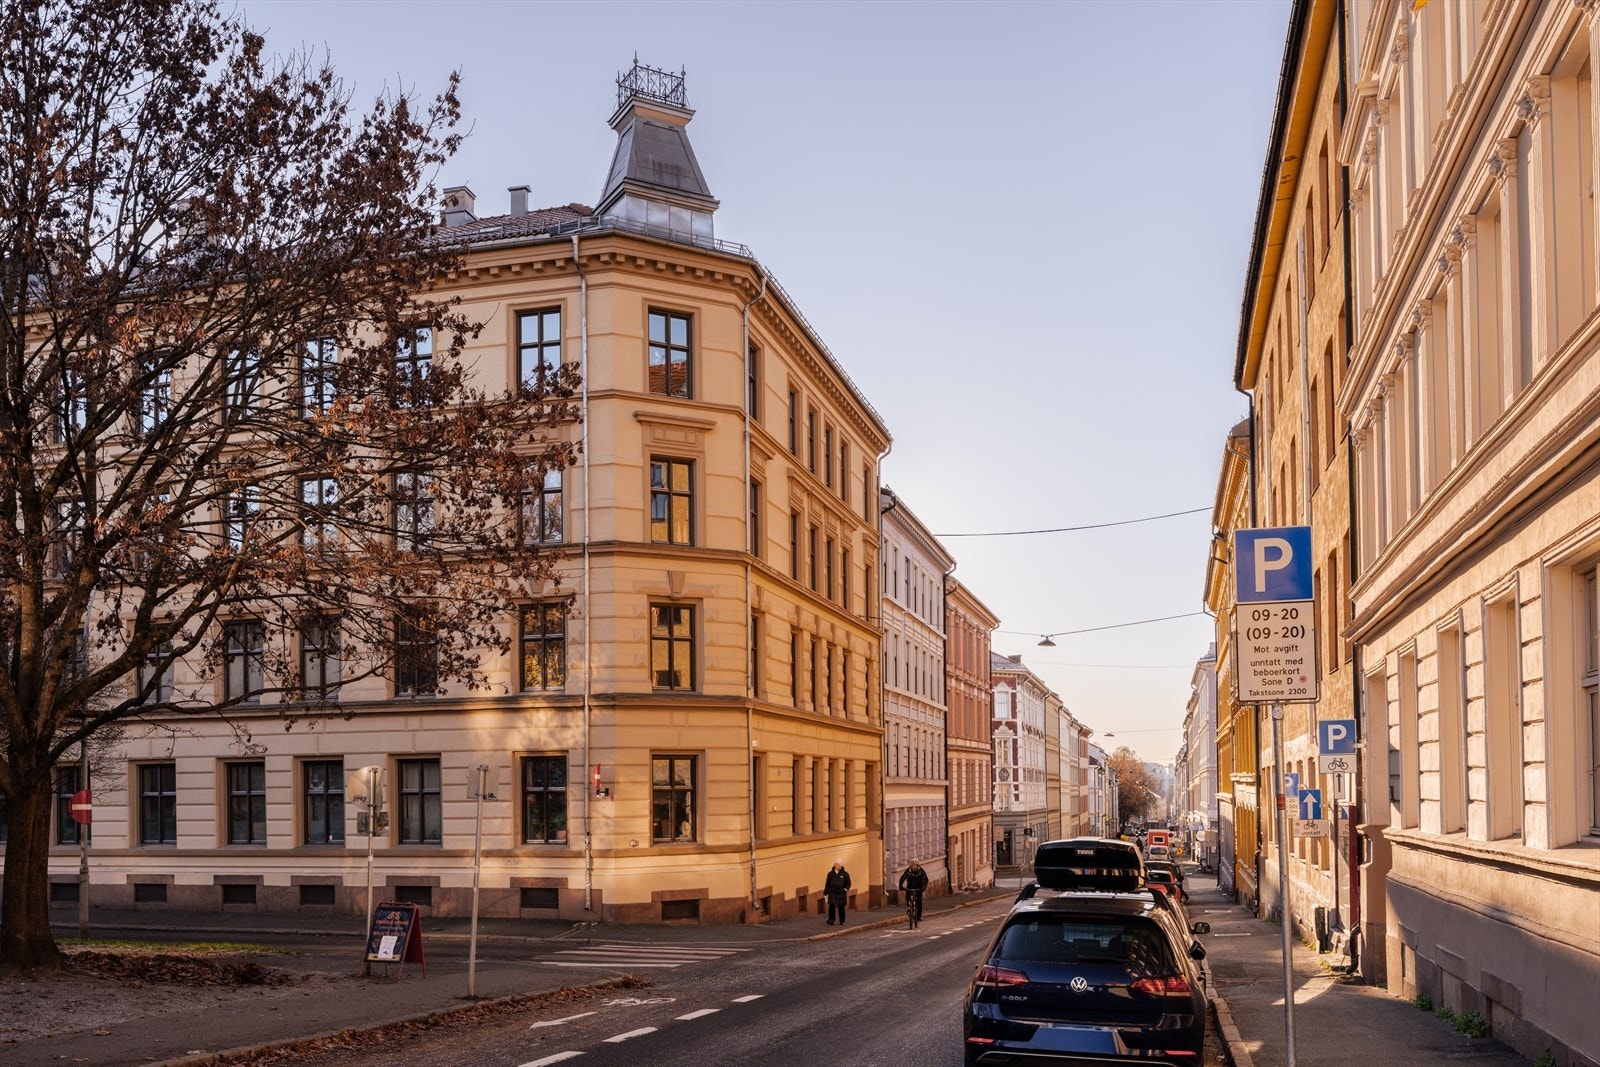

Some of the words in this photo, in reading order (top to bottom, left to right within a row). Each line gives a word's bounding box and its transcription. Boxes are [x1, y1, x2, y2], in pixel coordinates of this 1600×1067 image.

[1254, 537, 1293, 593] P
[1274, 644, 1298, 653] avgift
[1250, 658, 1281, 667] unntatt
[1285, 657, 1303, 665] med
[1253, 668, 1300, 676] beboerkort
[1261, 678, 1282, 686] Sone
[1287, 677, 1293, 685] D
[1248, 689, 1284, 697] Takstsone
[1328, 724, 1347, 750] P
